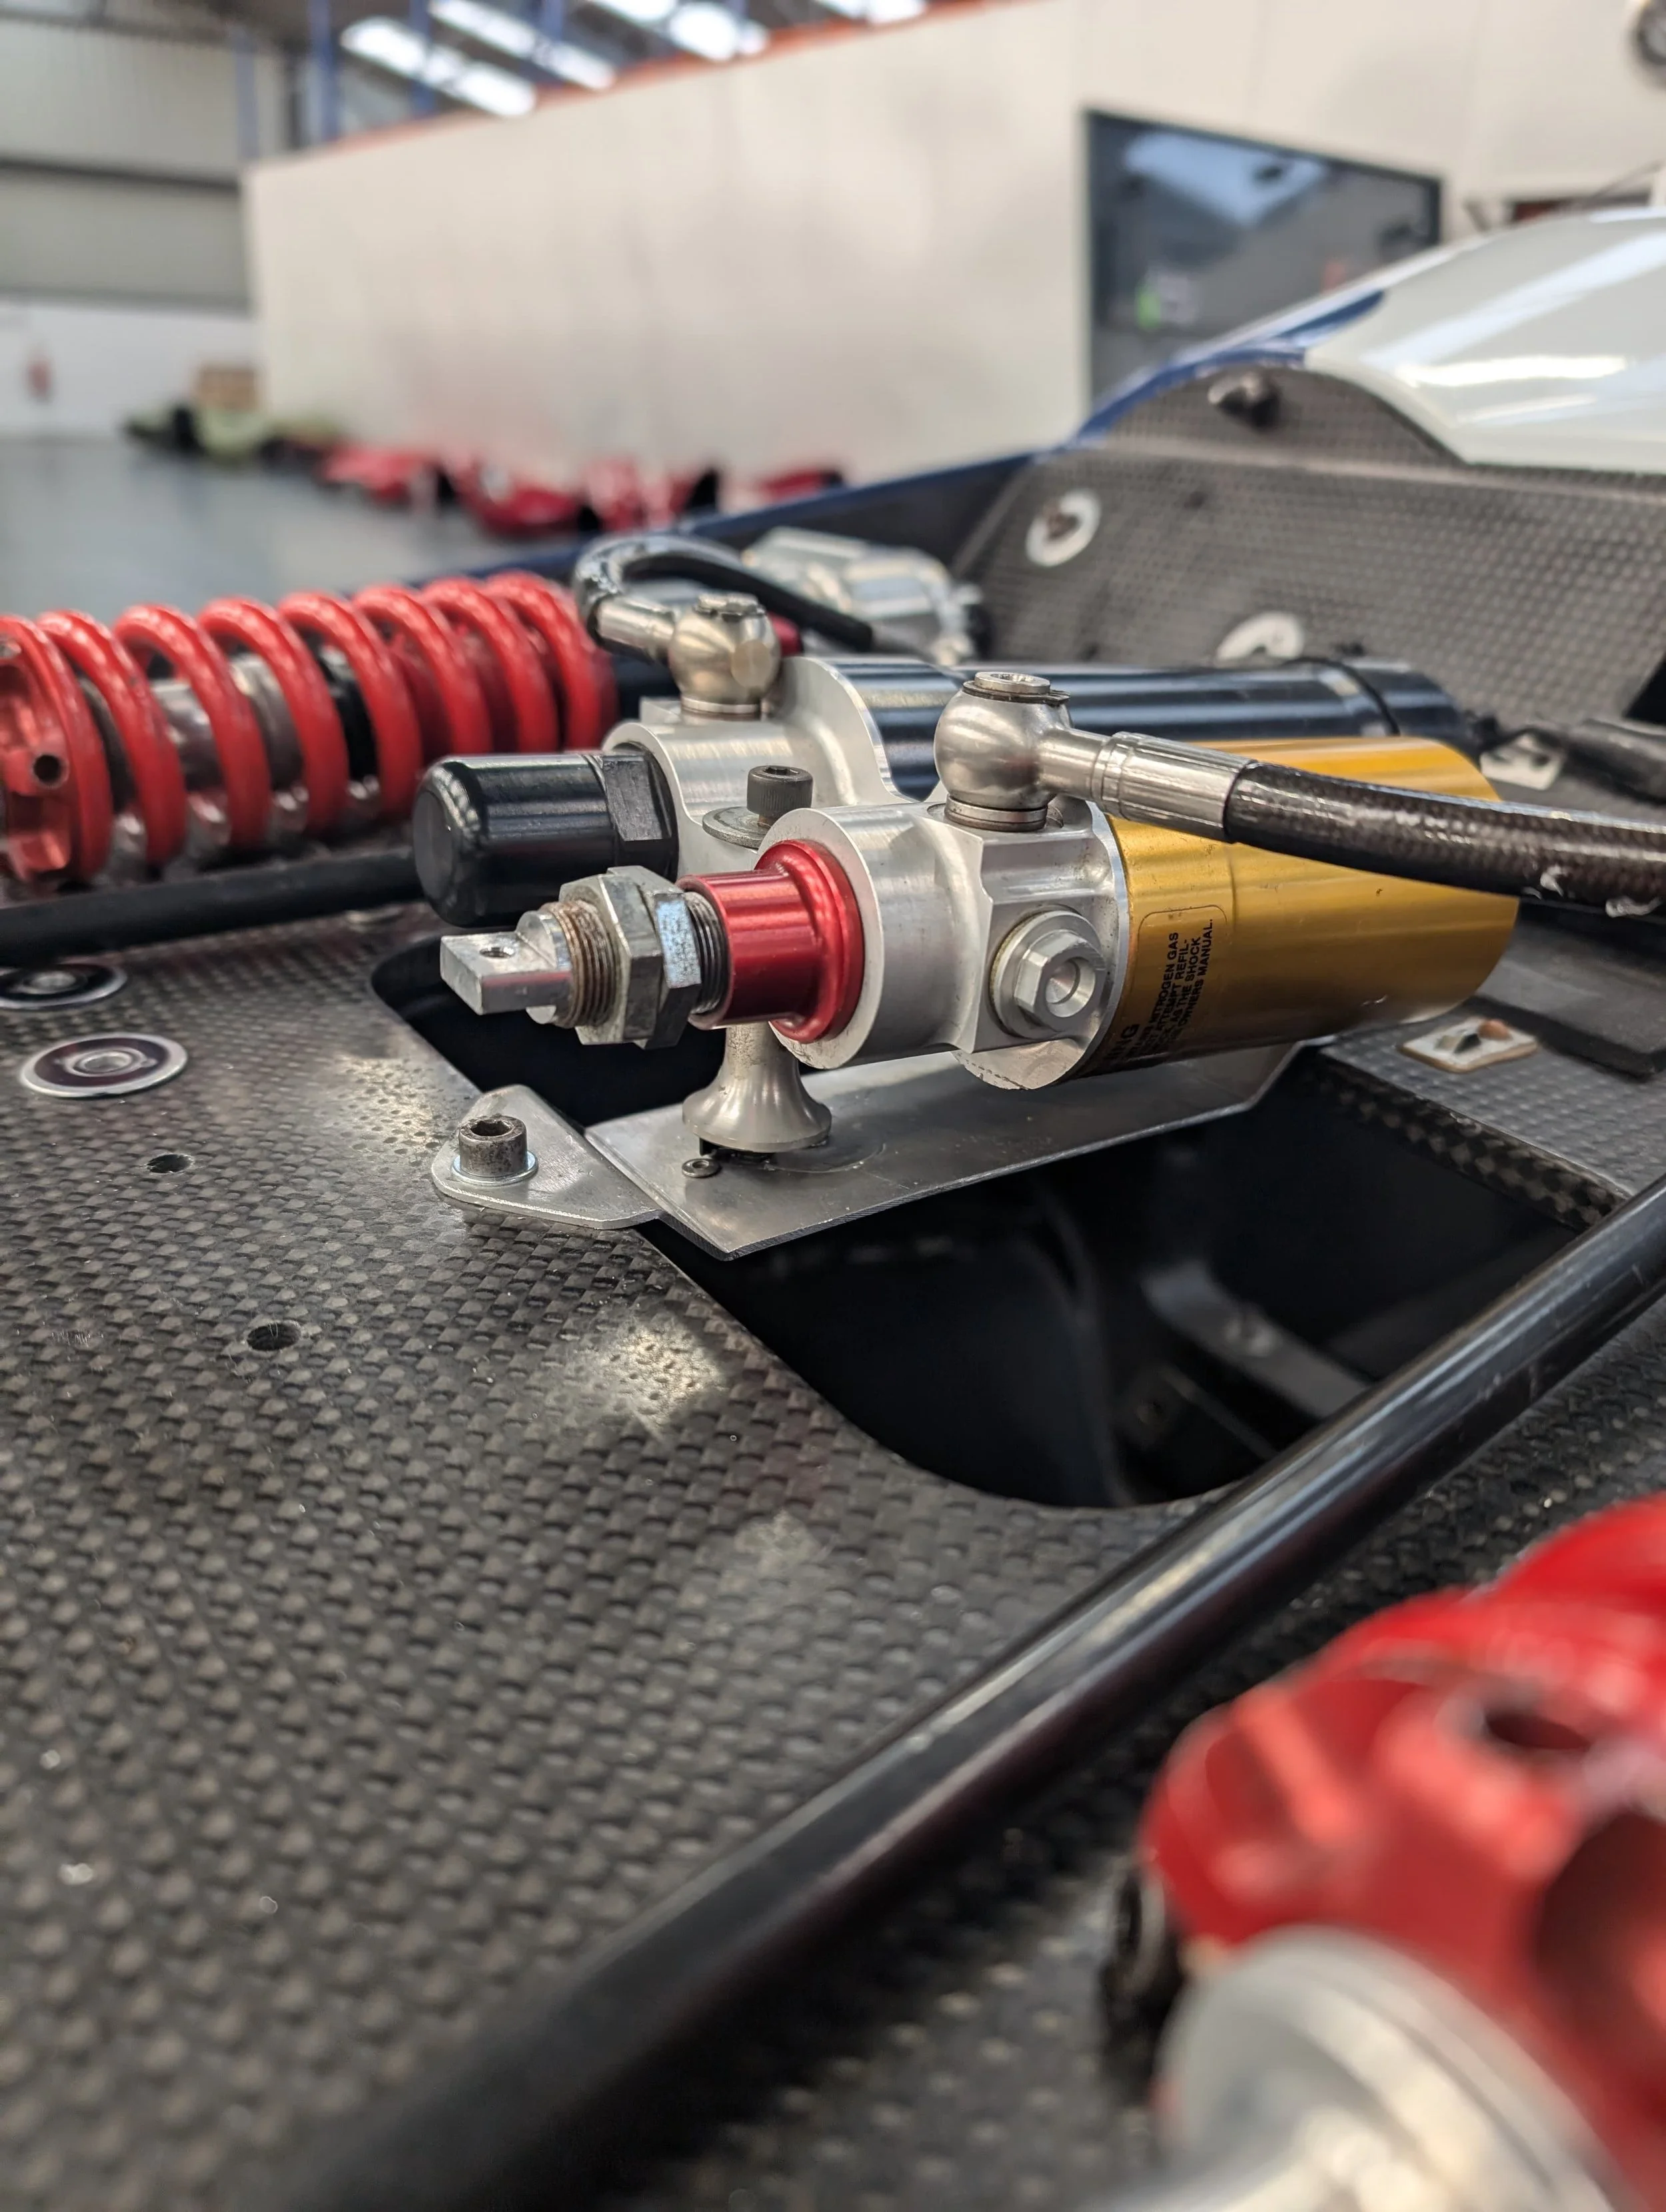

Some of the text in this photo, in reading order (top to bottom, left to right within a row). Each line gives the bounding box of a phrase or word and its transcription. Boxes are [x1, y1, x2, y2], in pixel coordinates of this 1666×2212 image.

[1148, 965, 1174, 1023] NITROGEN
[1167, 932, 1179, 959] GAS
[1176, 985, 1192, 1008] THE
[1185, 936, 1202, 981] SHOCK
[1178, 919, 1214, 1027] OWNERS MANUAL.
